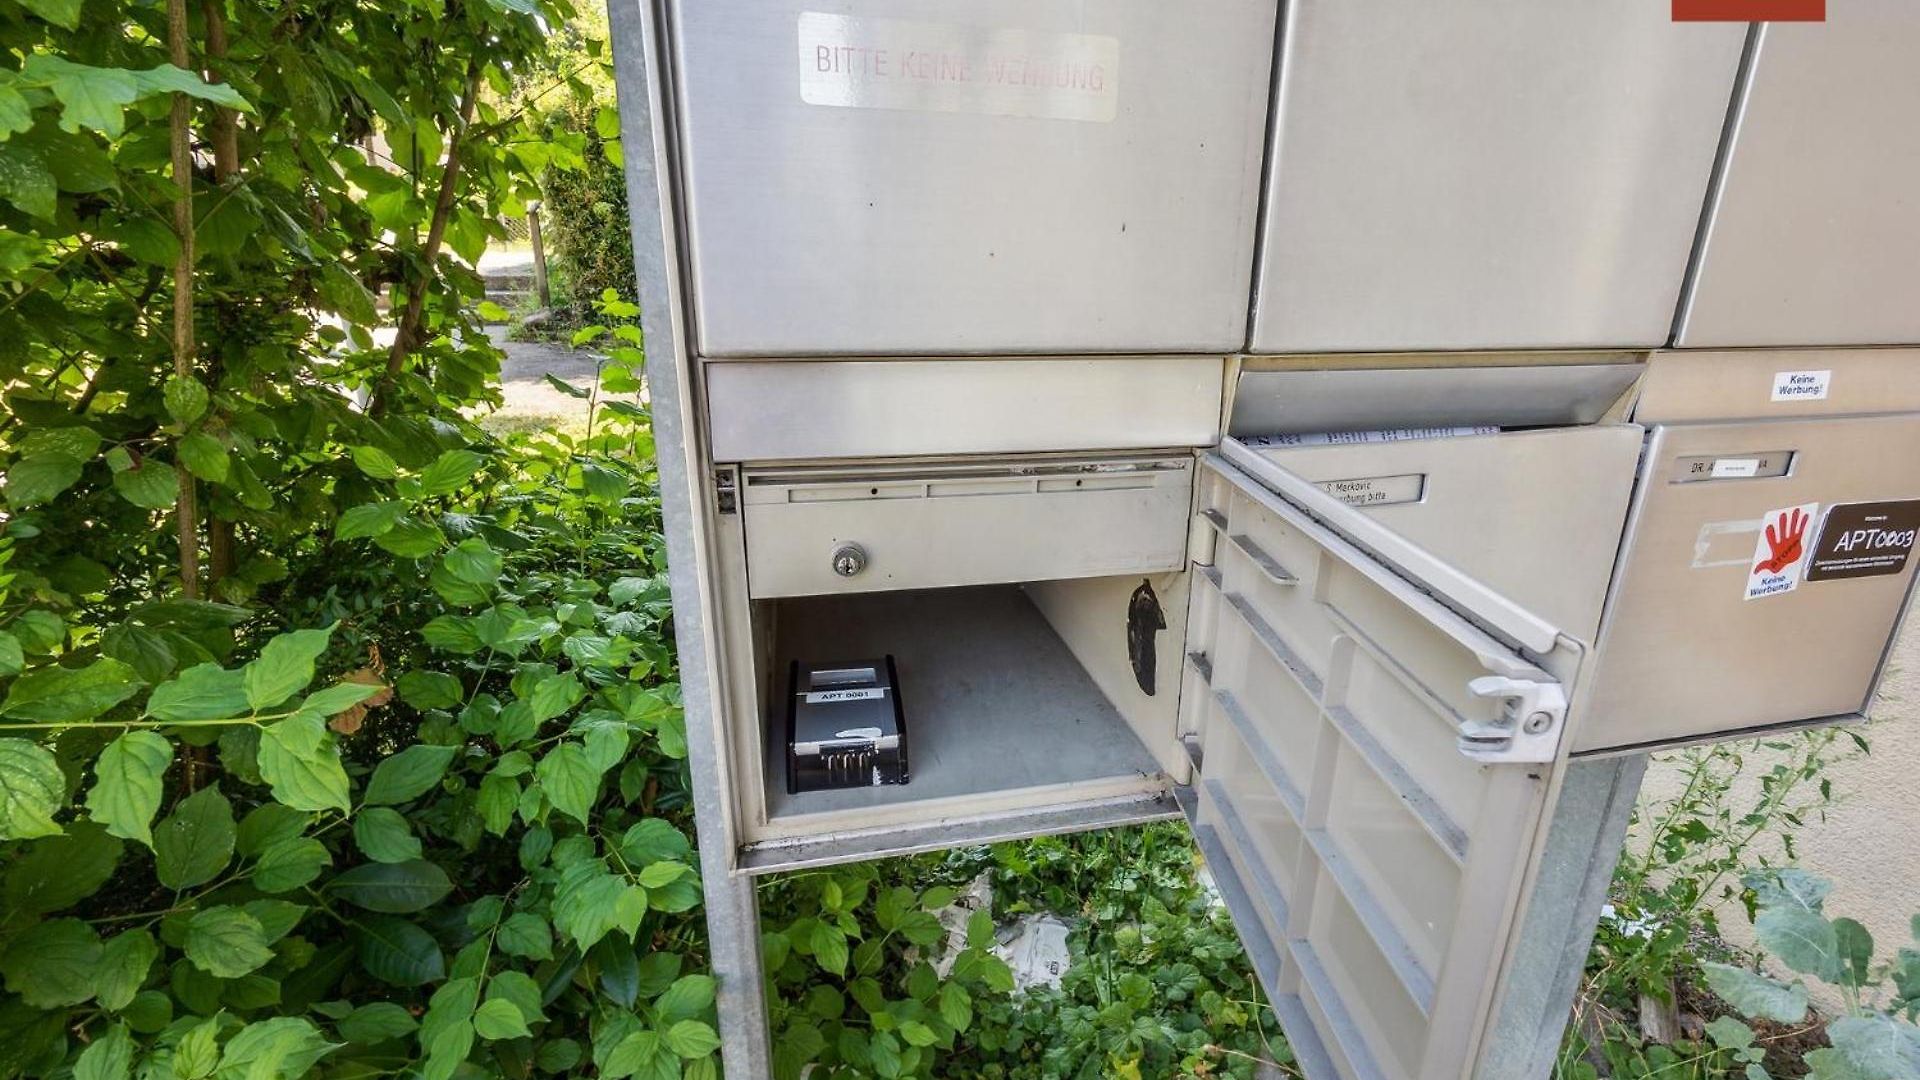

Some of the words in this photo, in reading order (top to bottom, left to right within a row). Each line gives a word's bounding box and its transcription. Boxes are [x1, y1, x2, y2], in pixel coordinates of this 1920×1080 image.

[816, 44, 888, 76] BITTE
[901, 52, 971, 82] KEINE
[1790, 374, 1815, 384] Keine
[1762, 575, 1786, 586] Keine
[1750, 581, 1793, 596] Werbung!
[821, 692, 842, 700] APT
